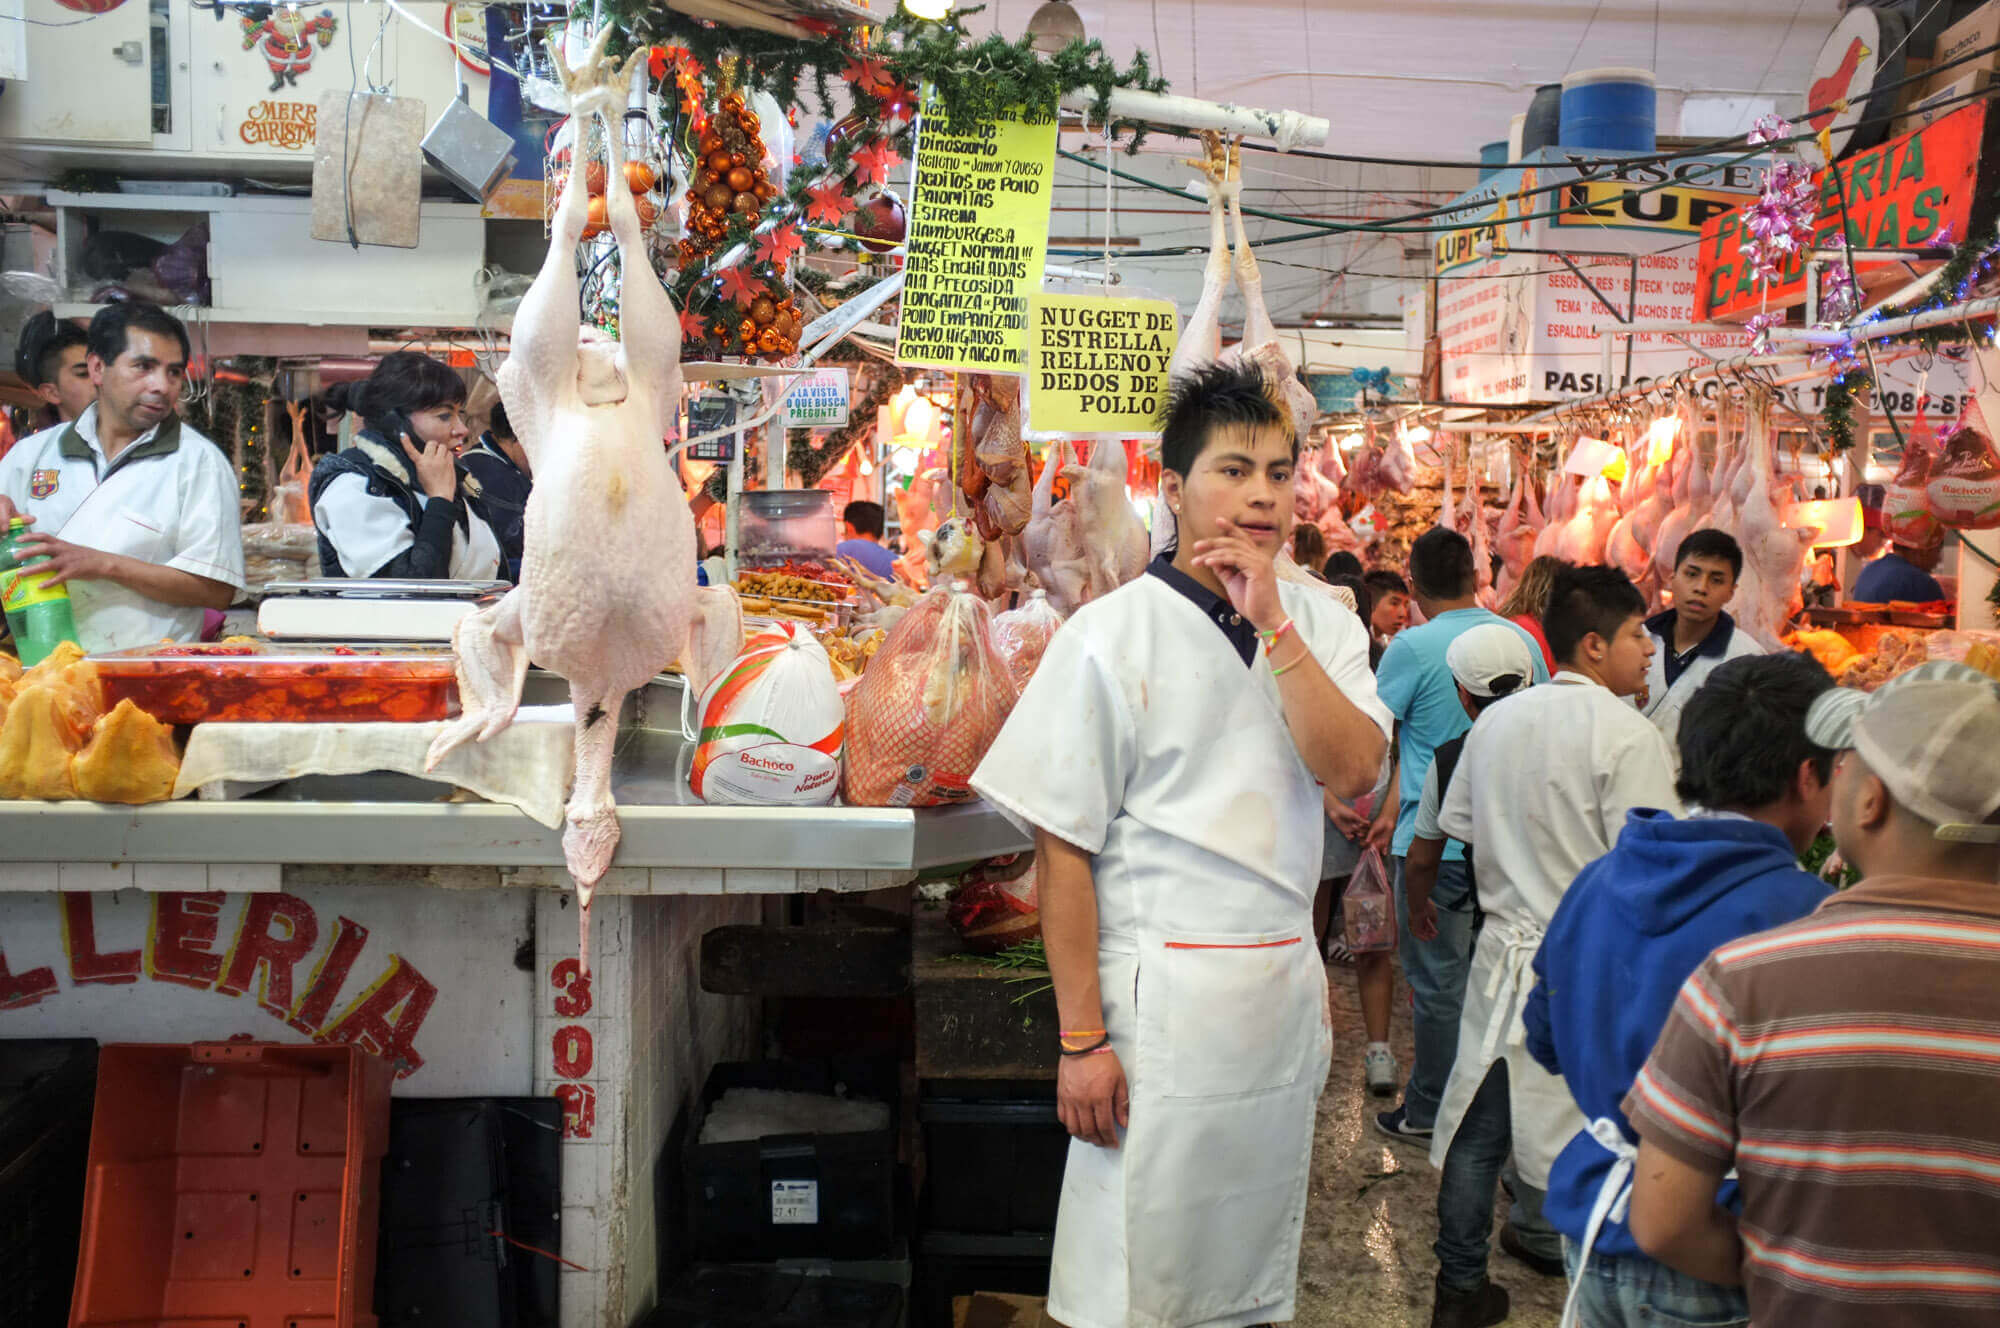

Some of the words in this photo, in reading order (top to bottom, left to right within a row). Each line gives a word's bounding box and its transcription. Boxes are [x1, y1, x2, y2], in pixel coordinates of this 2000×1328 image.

[1565, 154, 1764, 190] VISCE
[1639, 256, 1680, 271] COMBOS
[1548, 274, 1579, 289] SESOS
[1596, 277, 1614, 291] RES
[1555, 299, 1582, 313] TEMA
[1040, 307, 1140, 328] NUGGET
[1145, 312, 1173, 331] DE
[1040, 329, 1171, 354] ESTRELLA,
[1040, 351, 1151, 372] RELLENO
[1156, 355, 1170, 373] Y
[810, 387, 838, 397] VISTA
[1040, 372, 1119, 393] DEDOS
[1130, 375, 1159, 393] DE
[795, 398, 813, 408] QUE
[815, 396, 846, 408] BUSCA
[1079, 394, 1156, 414] POLLO
[790, 407, 838, 418] PREGUNTE
[740, 752, 794, 772] Bachoco
[793, 770, 837, 794] Natural
[804, 770, 830, 783] Pavo
